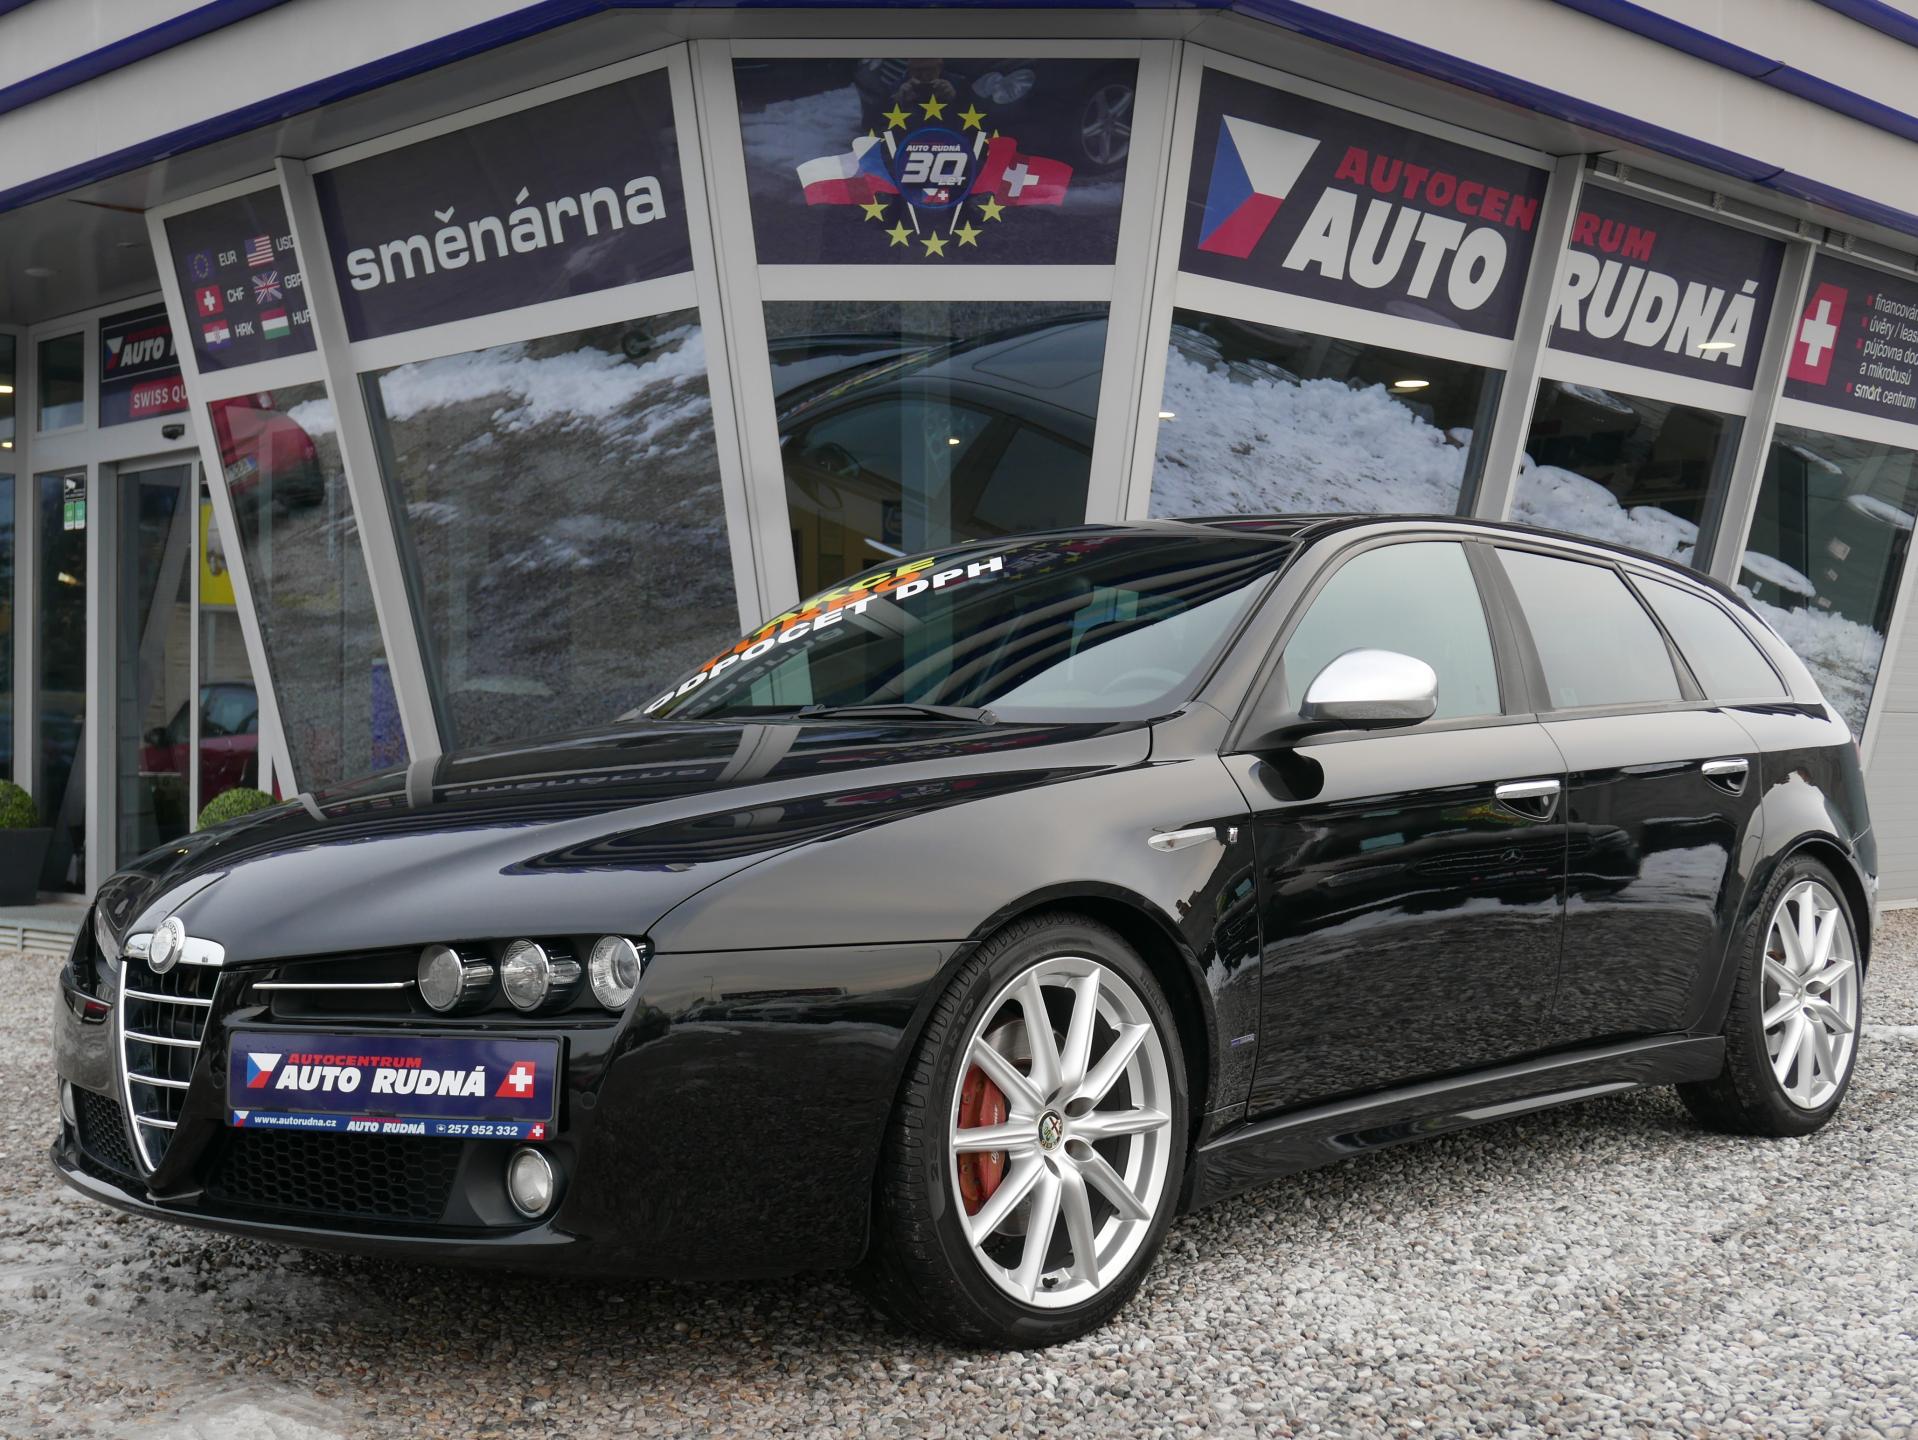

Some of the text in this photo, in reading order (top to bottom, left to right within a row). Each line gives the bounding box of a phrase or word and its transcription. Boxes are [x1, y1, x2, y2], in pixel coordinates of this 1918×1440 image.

[906, 144, 930, 152] AUTO
[901, 151, 969, 183] 30
[346, 176, 667, 291] směnárna
[218, 250, 238, 267] EUR
[1281, 186, 1759, 368] AUTO RUDNÁ
[226, 286, 245, 303] CHF
[234, 321, 255, 338] HRK
[120, 336, 165, 368] AUTO
[133, 387, 169, 409] SWISS
[1882, 390, 1917, 410] centrum
[896, 556, 1004, 601] DPH
[288, 1053, 423, 1068] AUTOCENTRUM
[275, 1065, 486, 1097] AUTO RUDNÁ
[254, 1115, 337, 1128] www.autorudna.cz
[346, 1120, 426, 1135] AUTO RUDNÁ
[447, 1124, 519, 1136] 257 952 332
